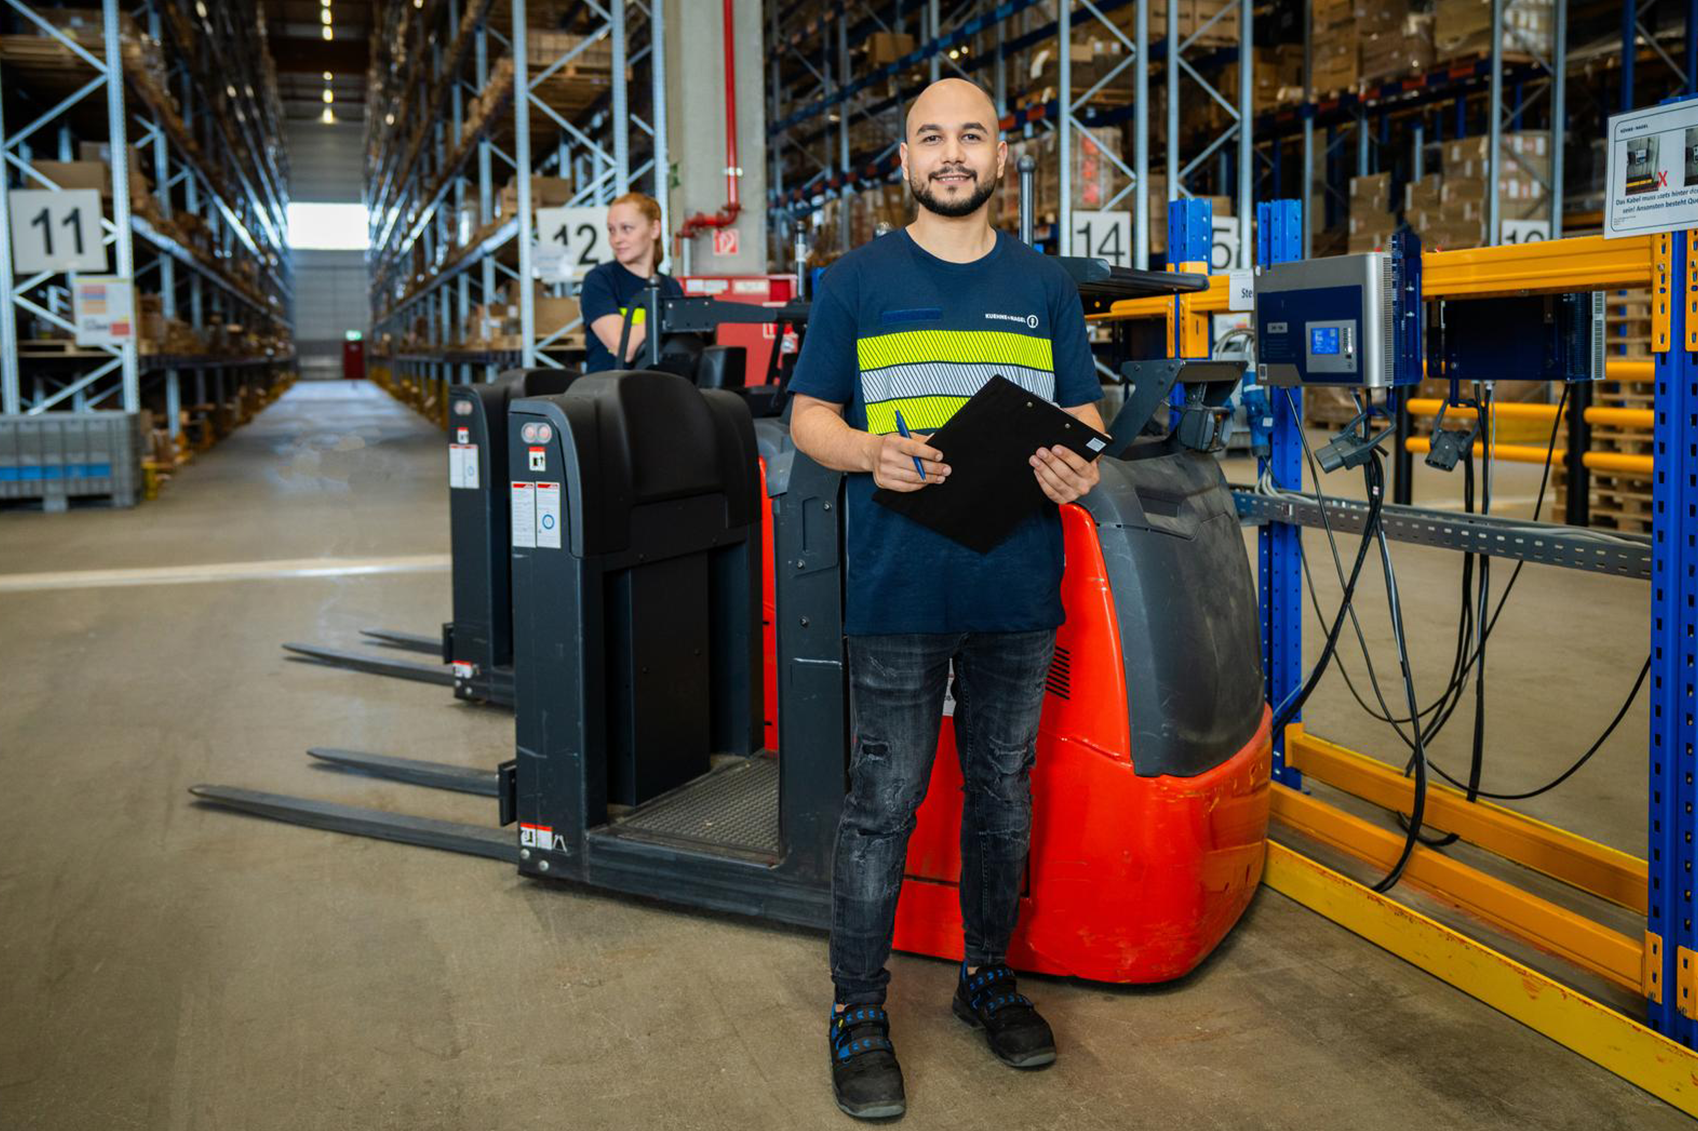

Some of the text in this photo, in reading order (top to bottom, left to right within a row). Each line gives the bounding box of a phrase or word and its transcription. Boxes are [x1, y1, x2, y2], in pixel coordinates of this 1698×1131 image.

[1636, 203, 1664, 211] Ansonsten
[1666, 199, 1687, 208] besteht
[1671, 189, 1688, 197] hinter
[31, 207, 84, 255] 11
[1076, 221, 1126, 267] 14
